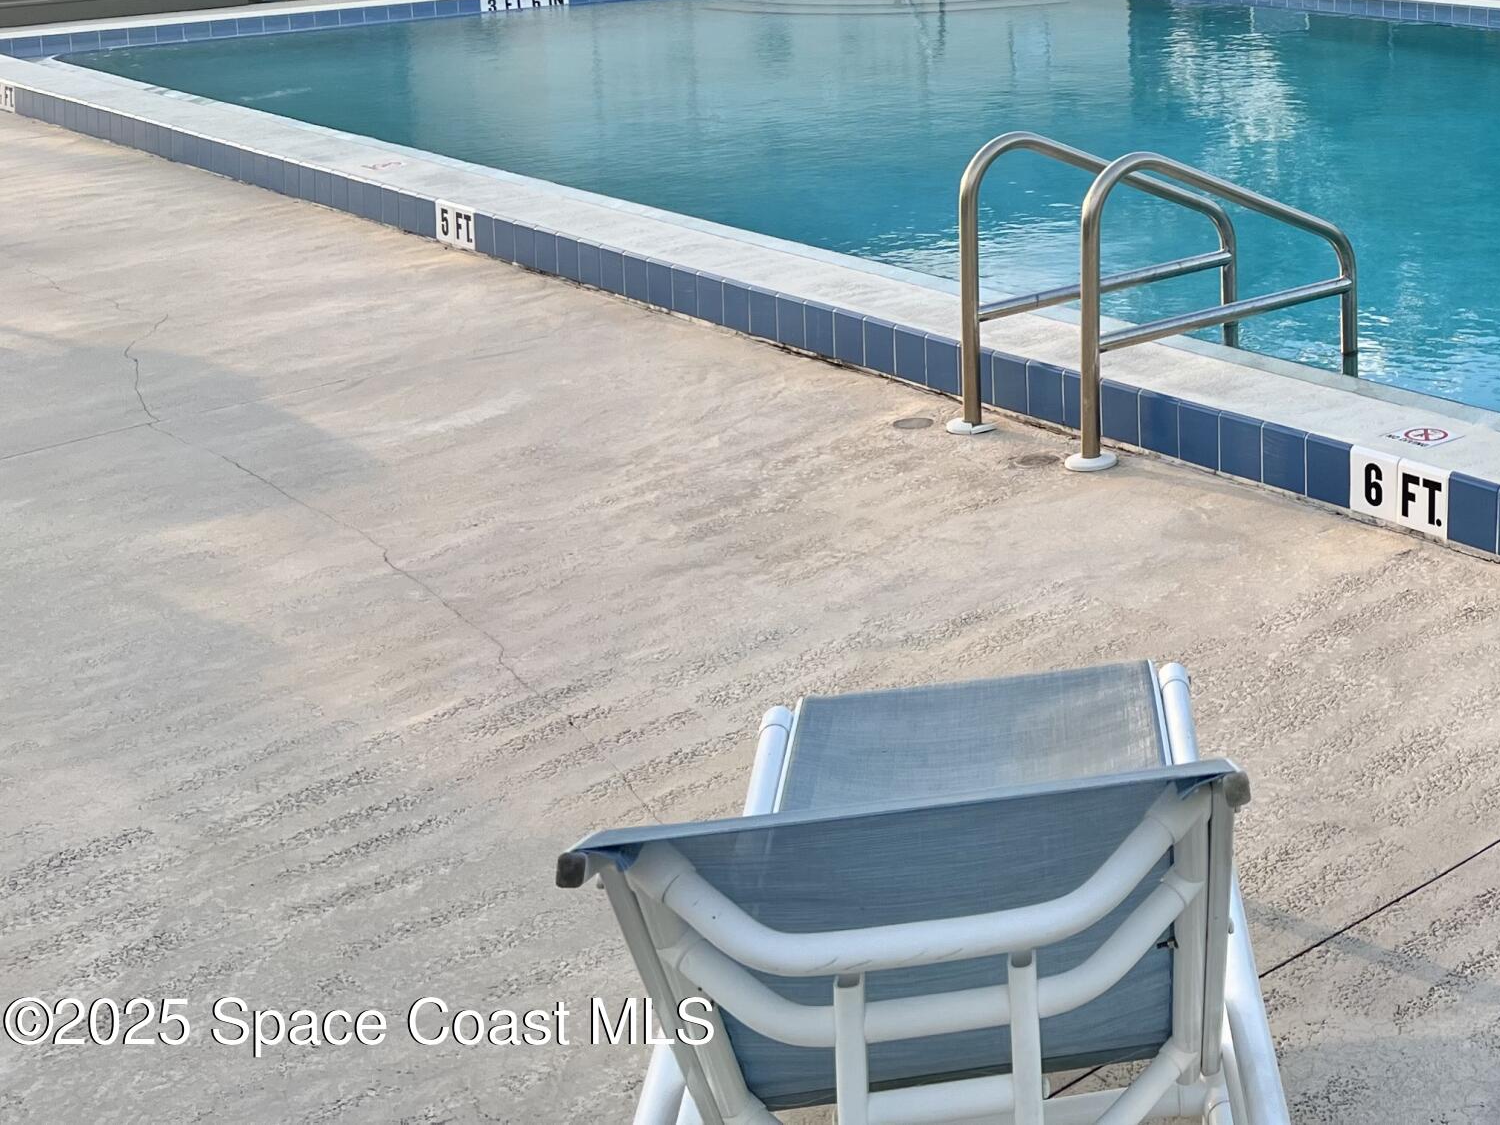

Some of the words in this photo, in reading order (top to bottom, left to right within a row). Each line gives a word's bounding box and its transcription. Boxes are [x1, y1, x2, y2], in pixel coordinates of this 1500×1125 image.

[488, 0, 497, 11] 3
[441, 208, 449, 236] 5
[455, 212, 473, 243] FT.
[1365, 463, 1383, 507] 6
[1402, 472, 1442, 527] FT.
